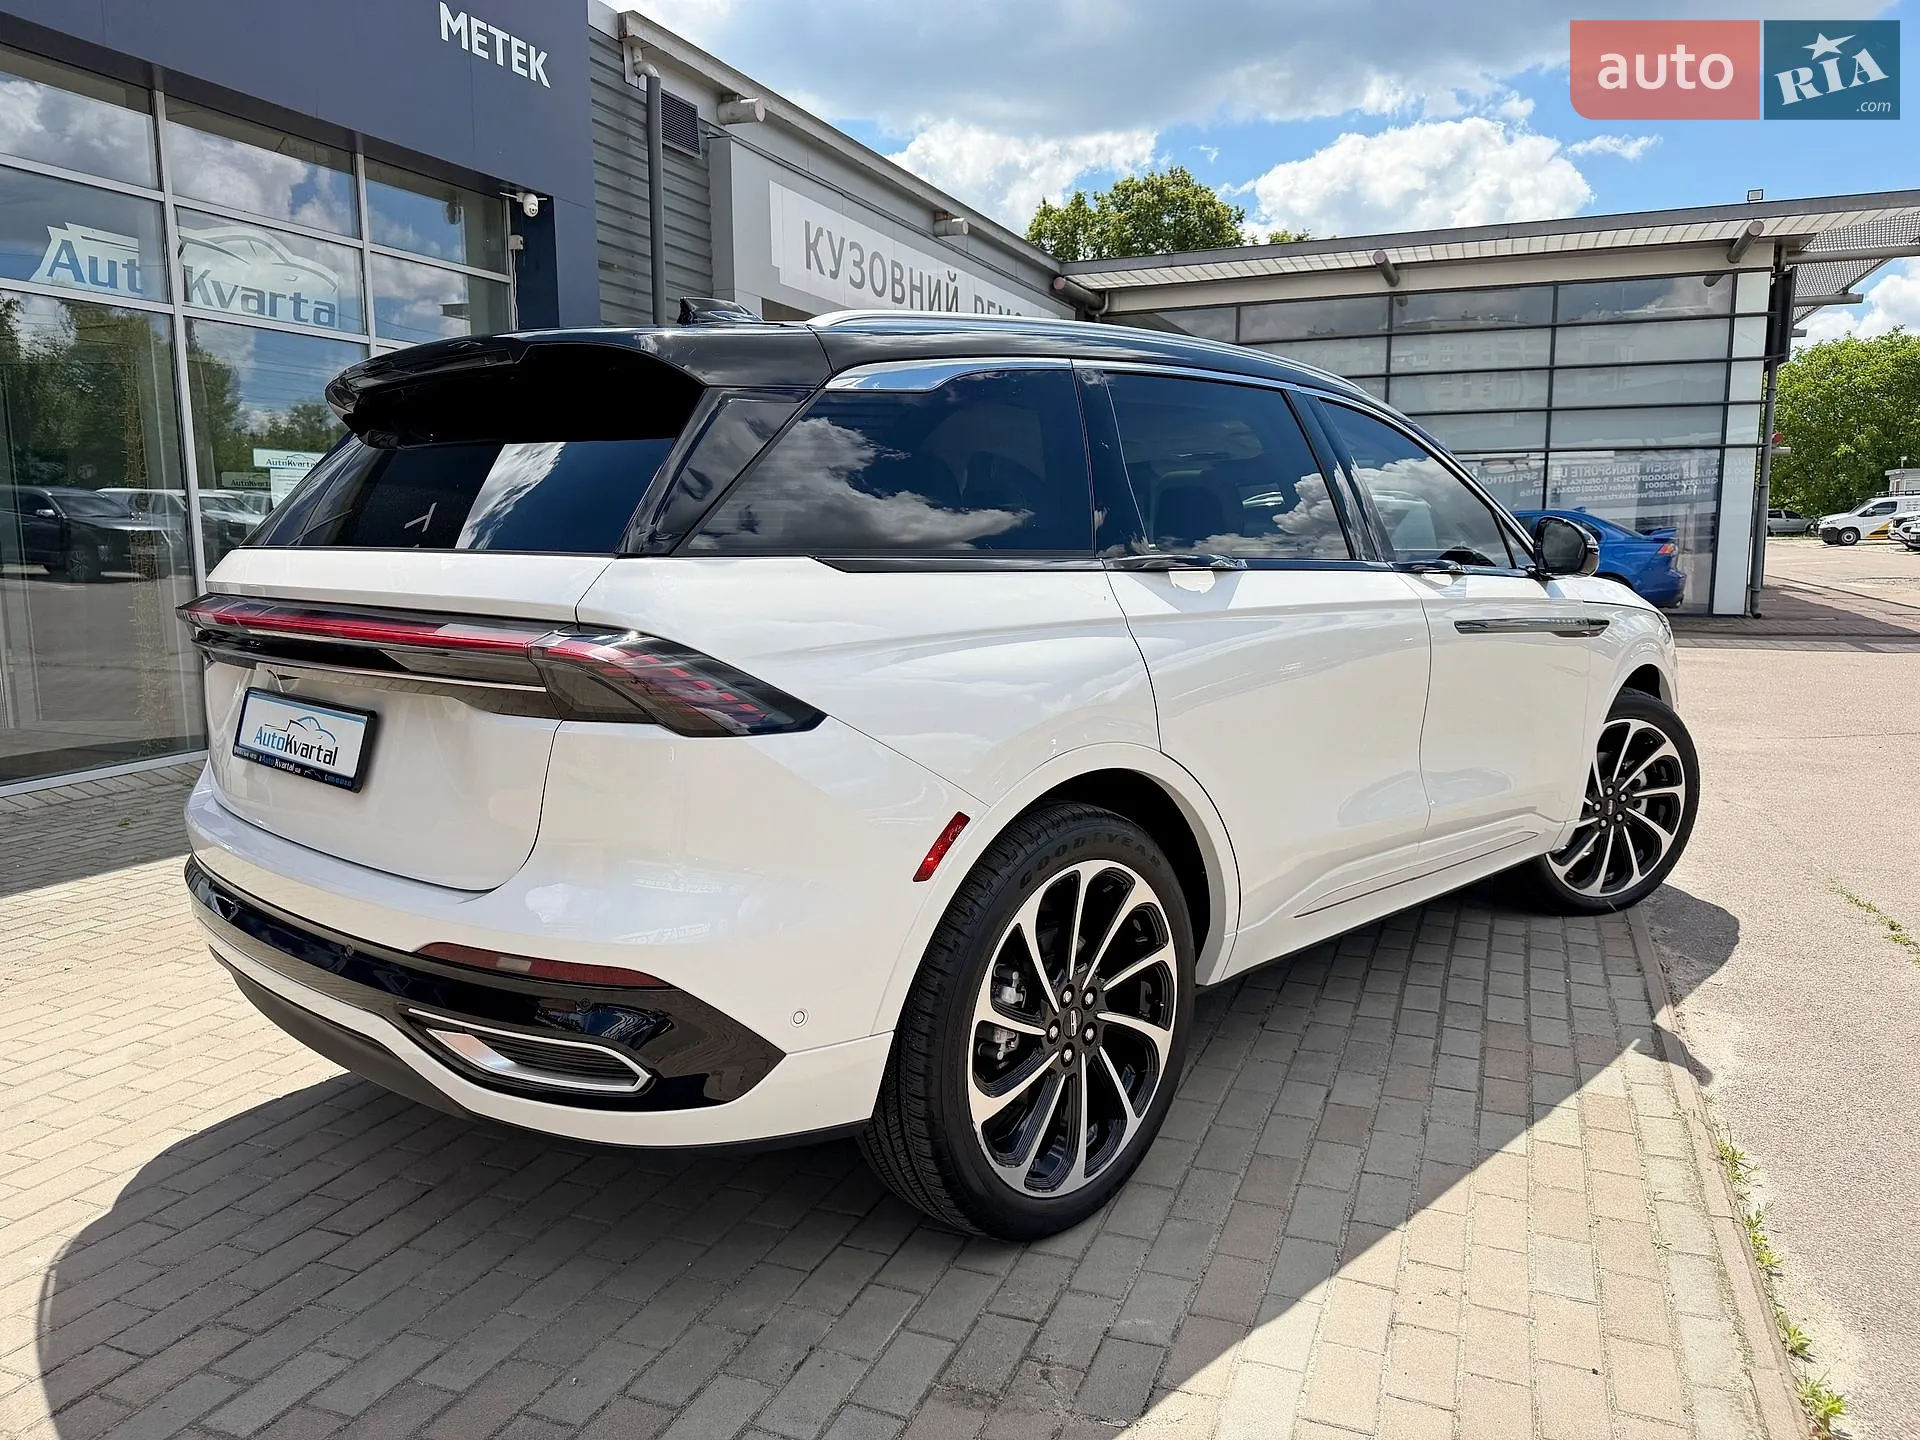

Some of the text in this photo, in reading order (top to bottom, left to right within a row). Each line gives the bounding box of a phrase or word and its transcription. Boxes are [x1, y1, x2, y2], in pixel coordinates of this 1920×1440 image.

[439, 1, 551, 89] METEK
[804, 219, 959, 312] КУЗОВНИЙ
[255, 726, 338, 766] AutoKvartal
